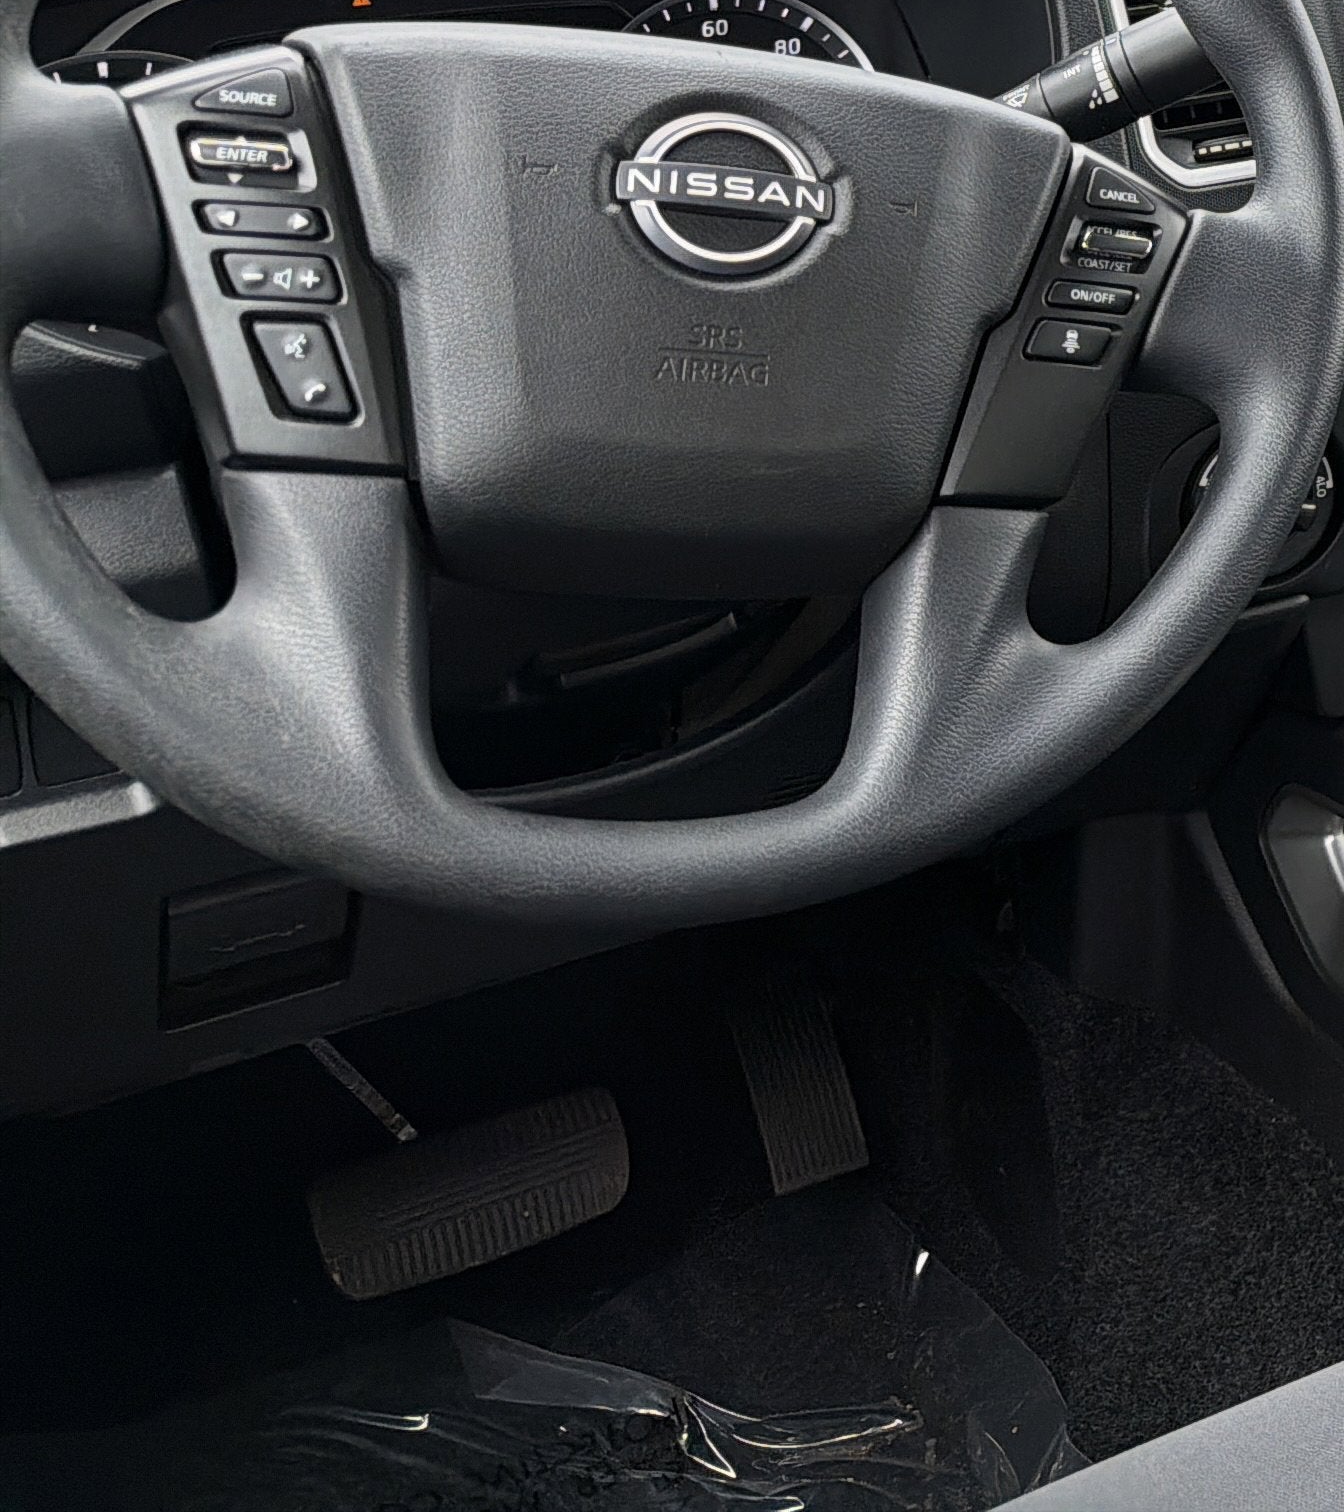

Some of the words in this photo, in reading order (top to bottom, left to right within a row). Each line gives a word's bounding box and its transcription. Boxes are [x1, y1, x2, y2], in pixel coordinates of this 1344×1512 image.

[701, 19, 729, 38] 60
[774, 37, 801, 56] 80
[1063, 64, 1082, 80] INT
[219, 89, 278, 107] SOURCE
[215, 146, 268, 163] ENTER
[626, 167, 826, 213] NISSAN
[1099, 188, 1141, 204] CANCEL
[1077, 256, 1133, 274] COAST/SET
[1070, 288, 1117, 305] ON/OFF
[688, 324, 746, 350] SRS
[654, 356, 772, 387] AIRBAG
